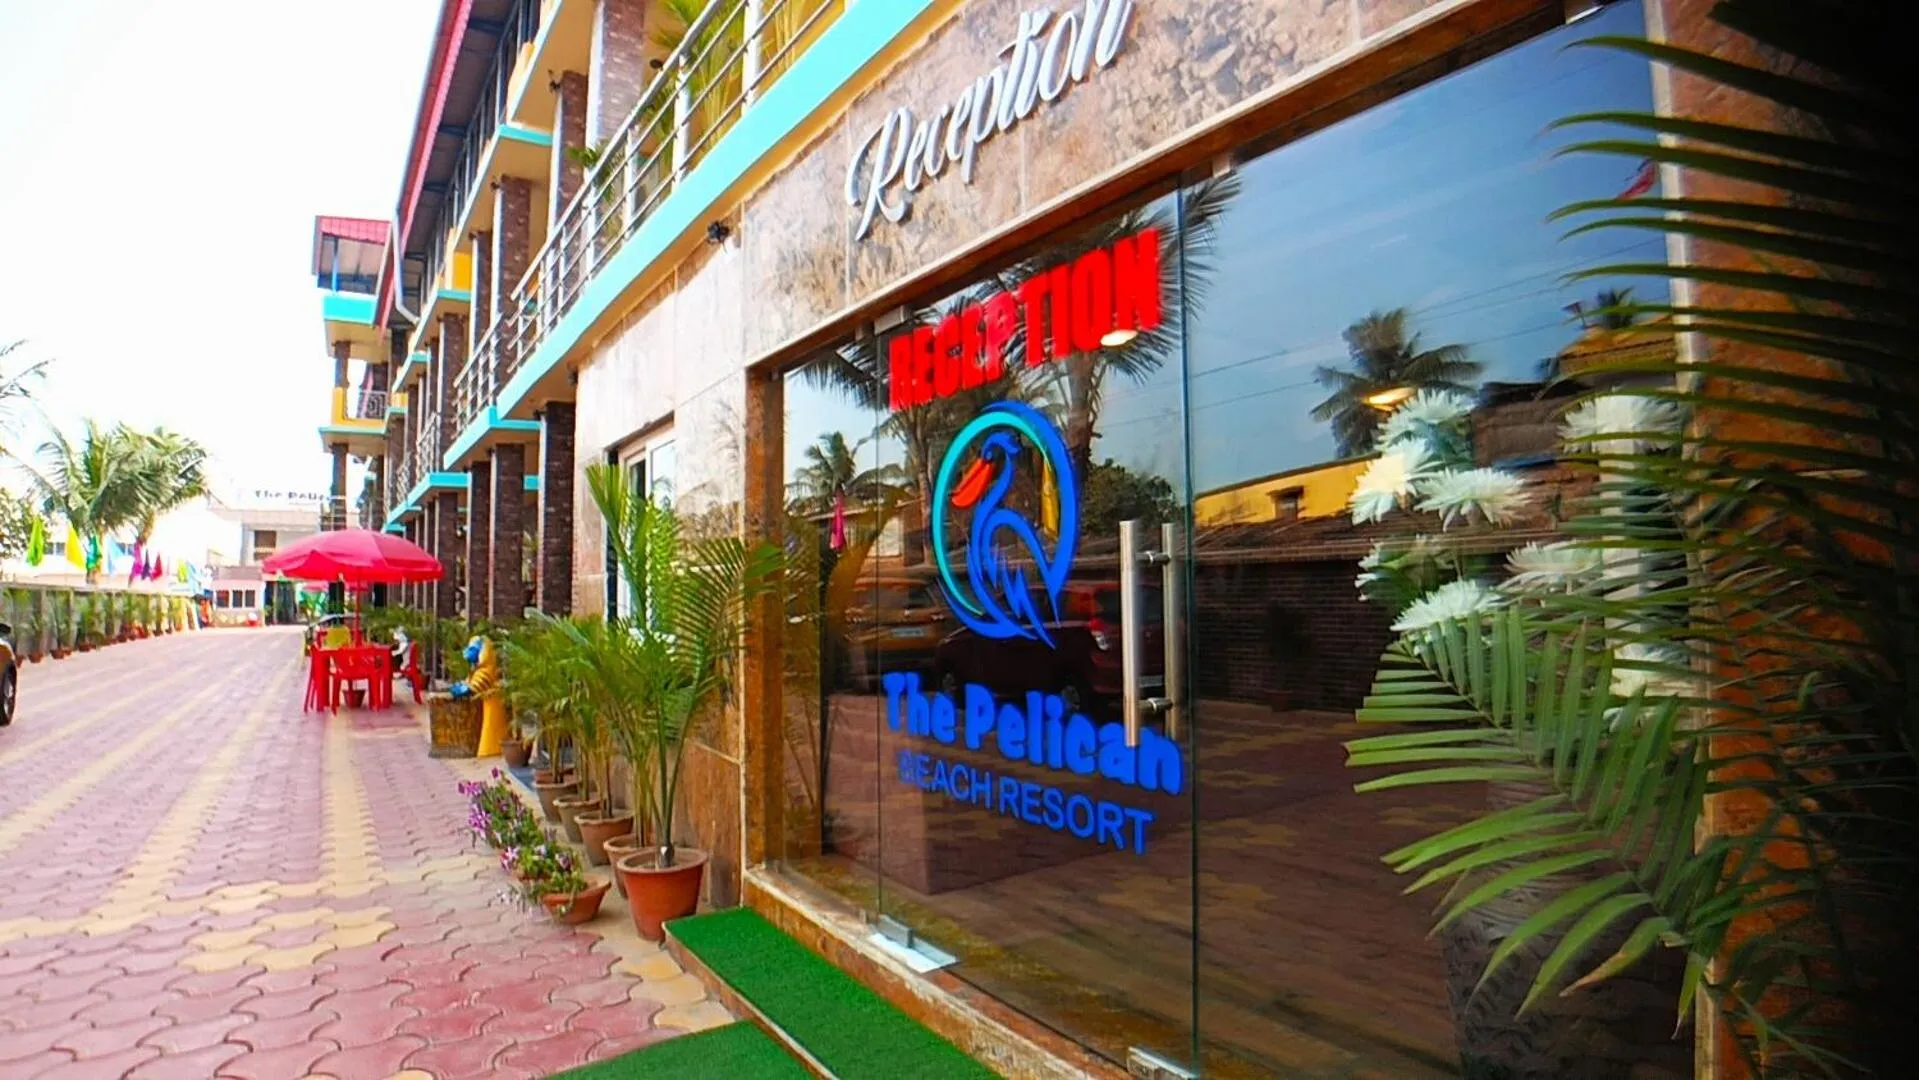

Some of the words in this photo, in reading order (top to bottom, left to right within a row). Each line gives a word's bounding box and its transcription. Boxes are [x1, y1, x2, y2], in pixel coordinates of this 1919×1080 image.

[846, 0, 1131, 240] Reception
[889, 227, 1160, 411] RECEPTION
[883, 672, 957, 743] The
[964, 683, 1183, 795] Pelican
[899, 748, 993, 810] BEACH
[1000, 775, 1155, 855] RESORT
